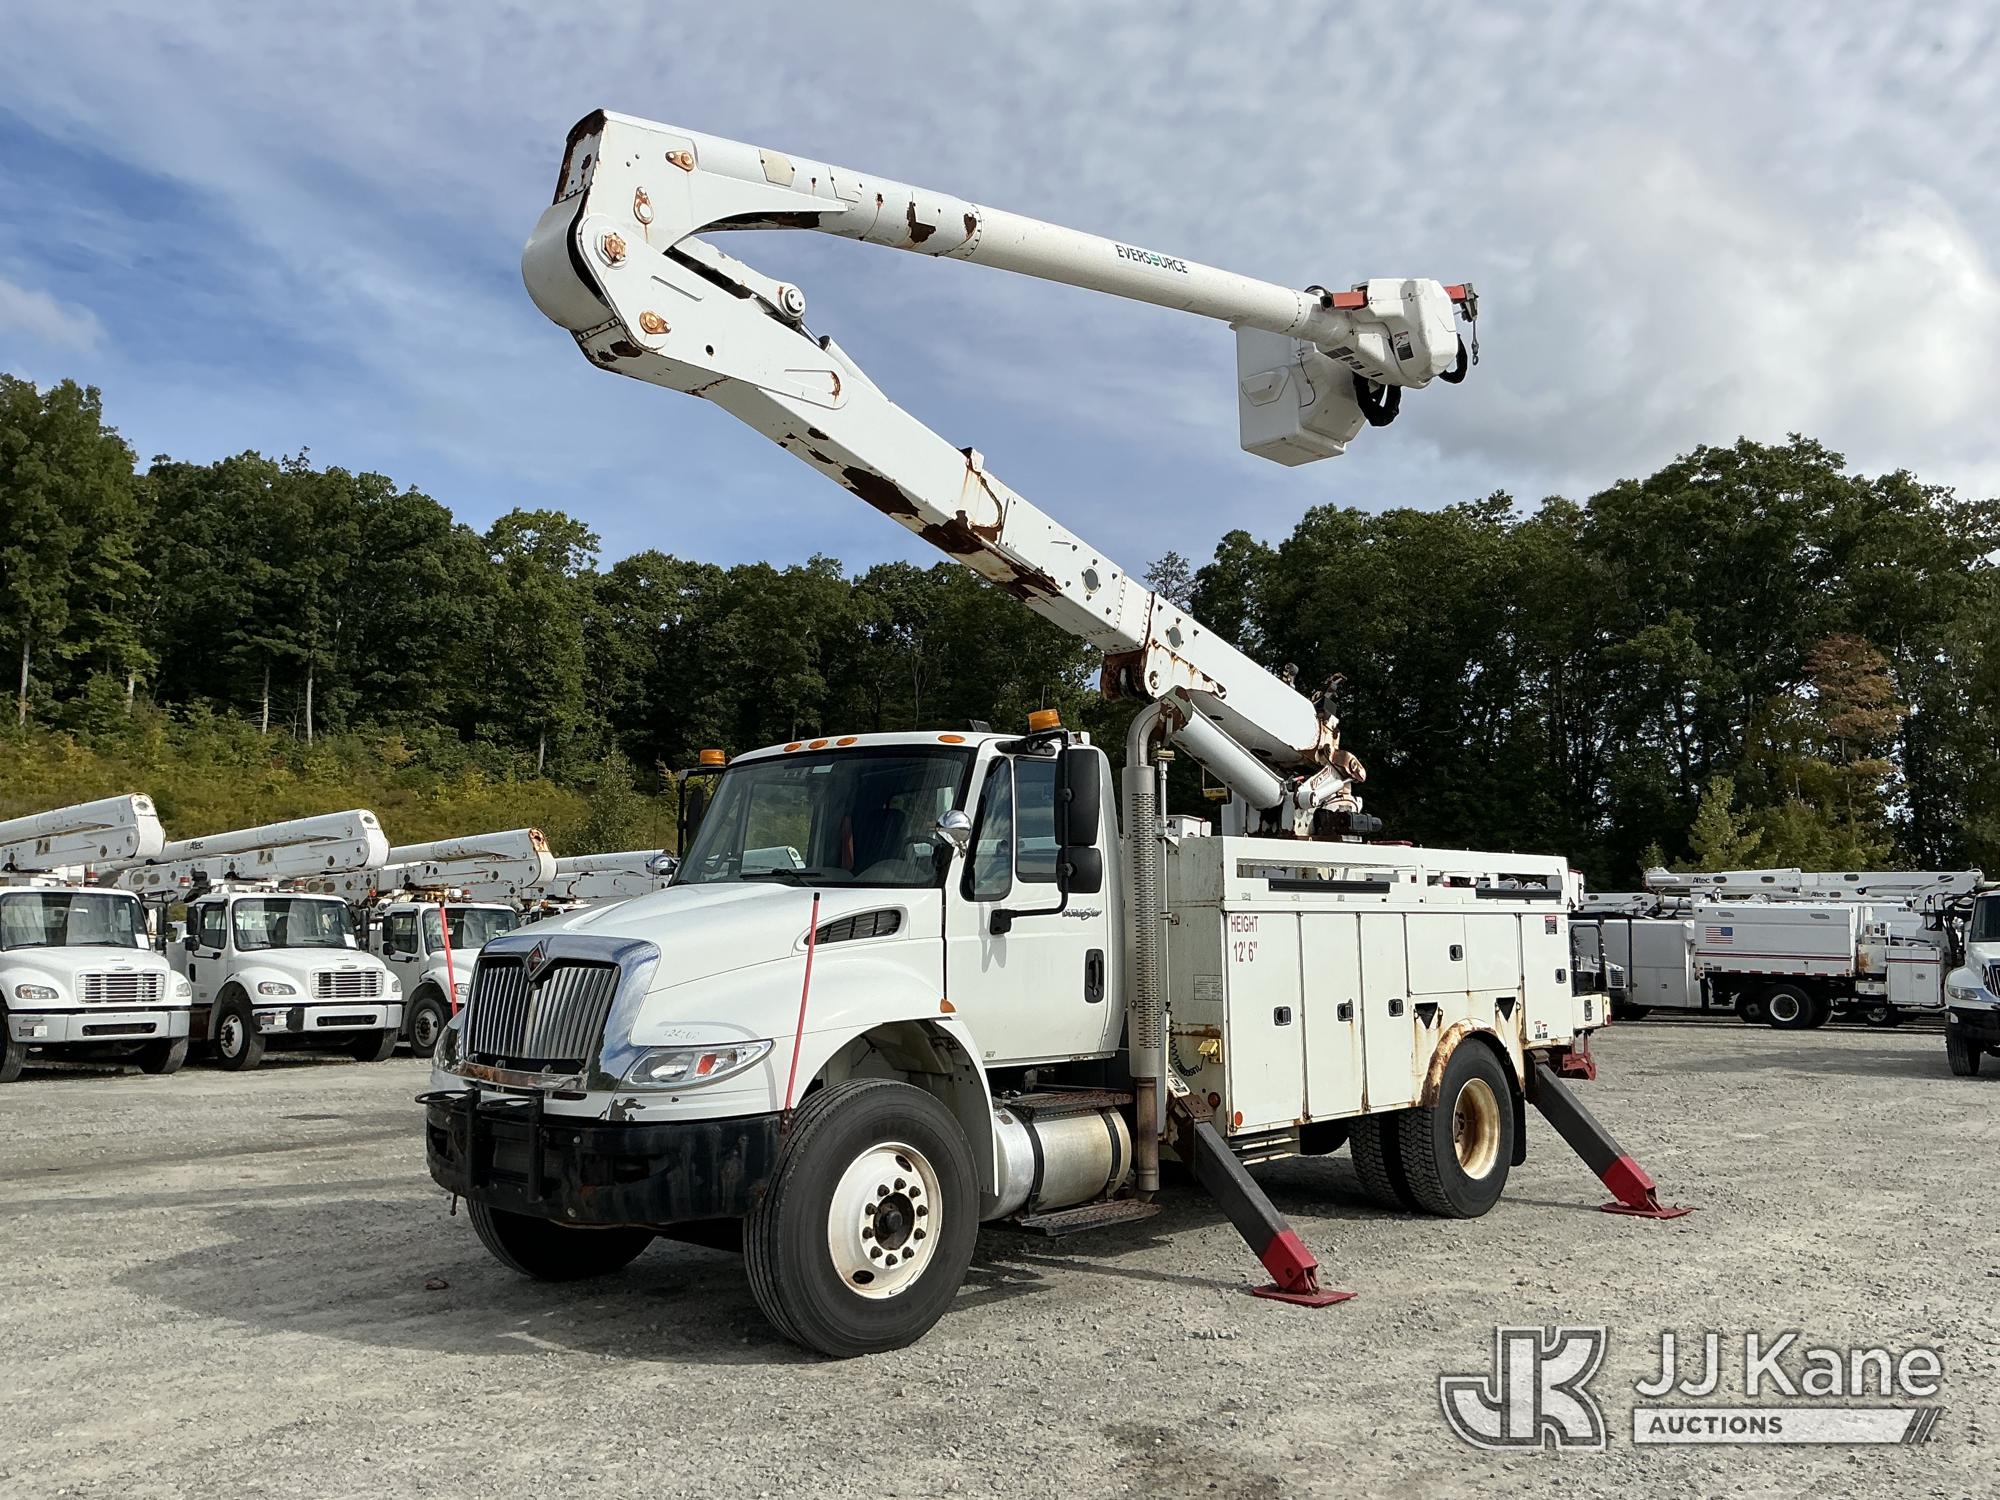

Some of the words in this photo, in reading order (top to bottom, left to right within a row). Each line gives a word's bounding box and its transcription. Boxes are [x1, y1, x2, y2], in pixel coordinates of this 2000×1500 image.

[1115, 244, 1188, 274] EVERSOURCE
[1692, 876, 1711, 884] Altec
[1230, 915, 1259, 933] HEIGHT
[1233, 941, 1246, 963] 12'
[1248, 941, 1258, 963] 6"
